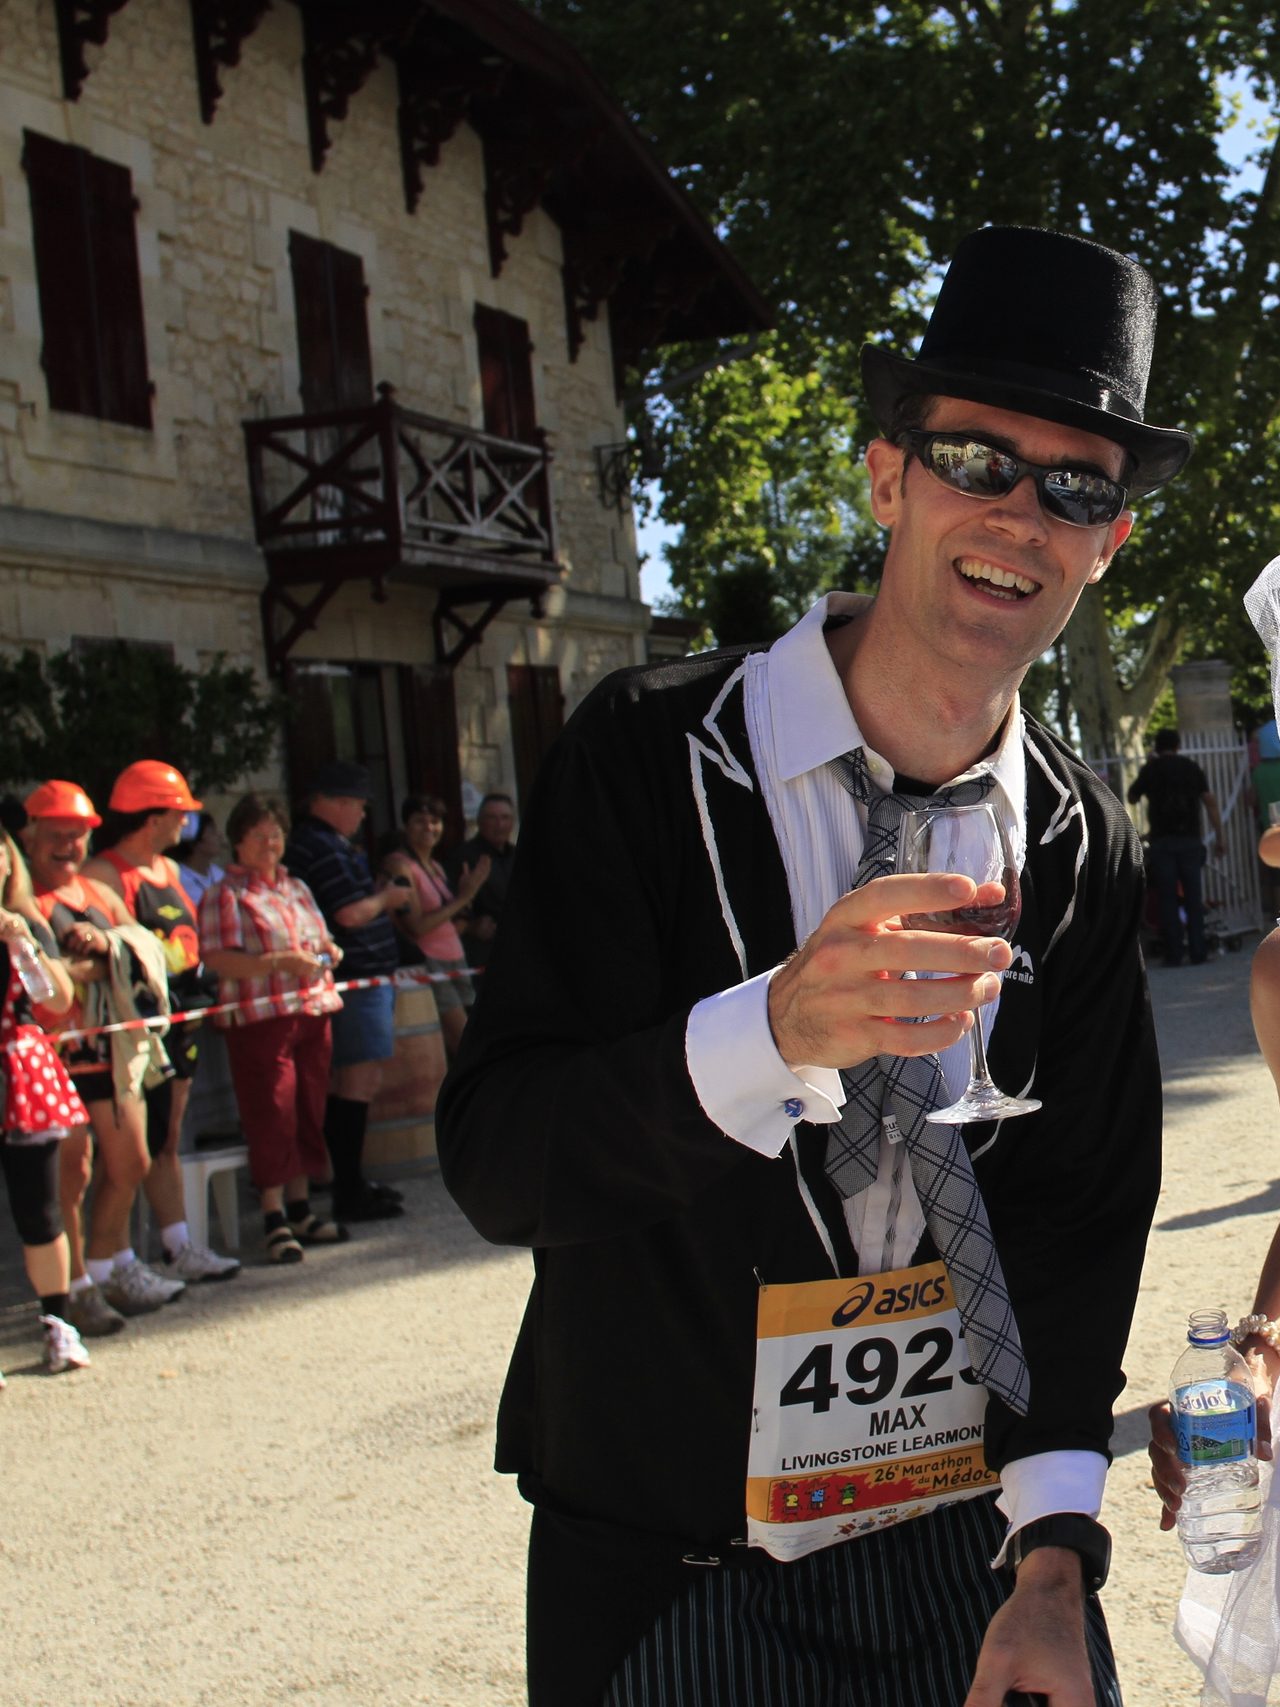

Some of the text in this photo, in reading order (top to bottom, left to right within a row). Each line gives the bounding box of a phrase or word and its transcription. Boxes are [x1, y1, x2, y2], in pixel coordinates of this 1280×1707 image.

[1003, 970, 1034, 984] ore mile
[869, 1403, 927, 1437] MAX
[781, 1441, 898, 1471] LIVINGSTONE
[902, 1455, 972, 1477] Marathon
[918, 1467, 993, 1489] du Médoc
